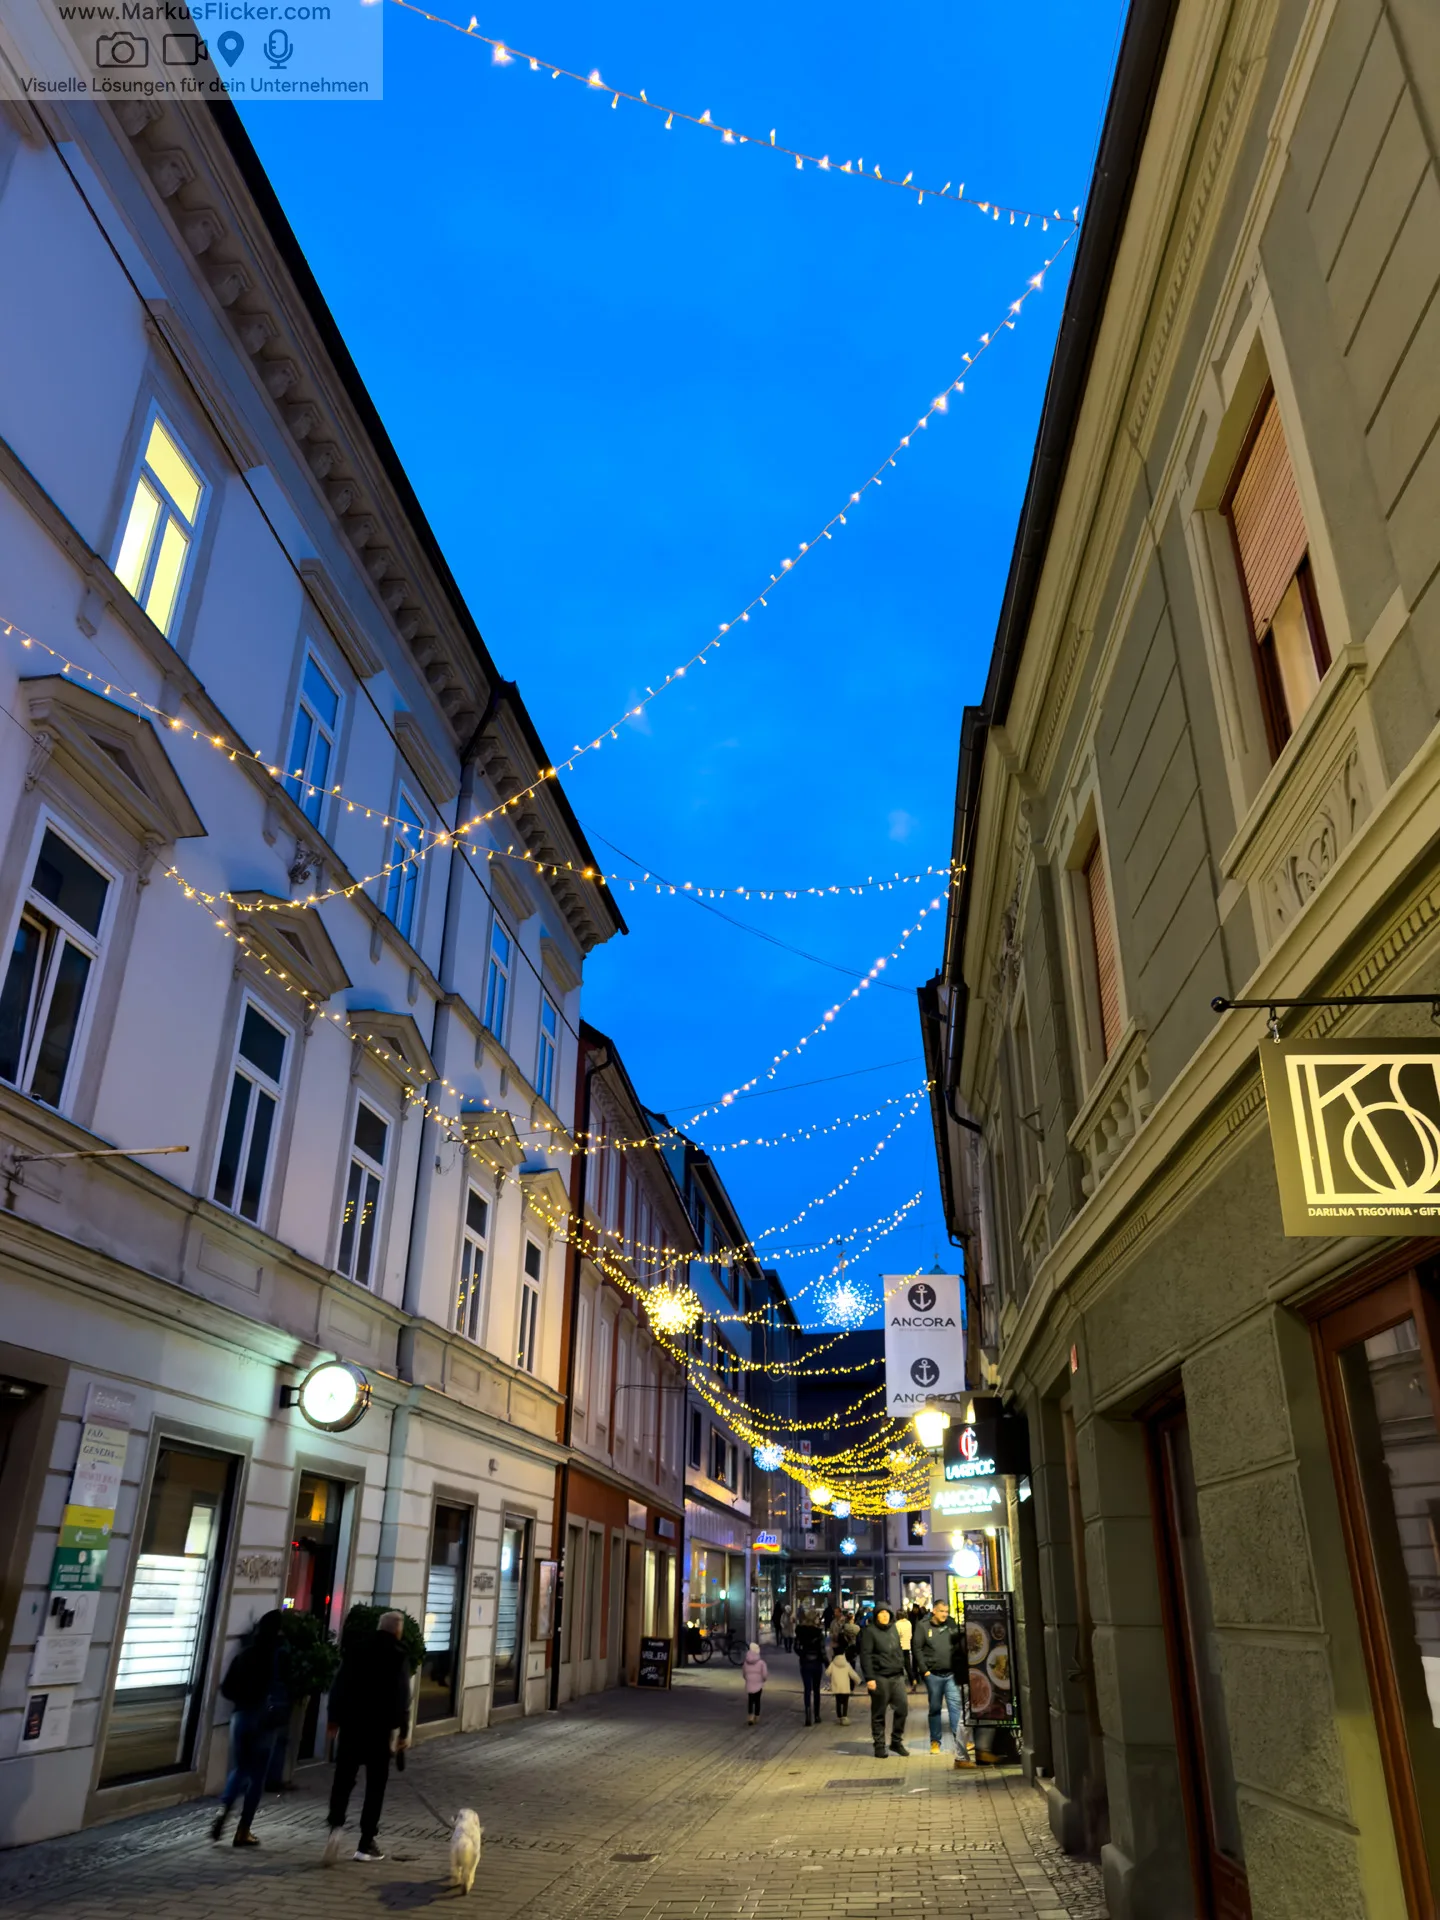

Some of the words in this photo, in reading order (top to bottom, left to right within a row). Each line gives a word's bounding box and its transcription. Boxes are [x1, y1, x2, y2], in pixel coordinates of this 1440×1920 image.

[1308, 1207, 1355, 1217] DARILNA
[1356, 1207, 1413, 1216] TRGOVINA
[891, 1317, 956, 1328] ANCORA
[933, 1486, 1002, 1510] ANCORA
[756, 1530, 777, 1545] dm
[966, 1603, 1003, 1613] ANCORA
